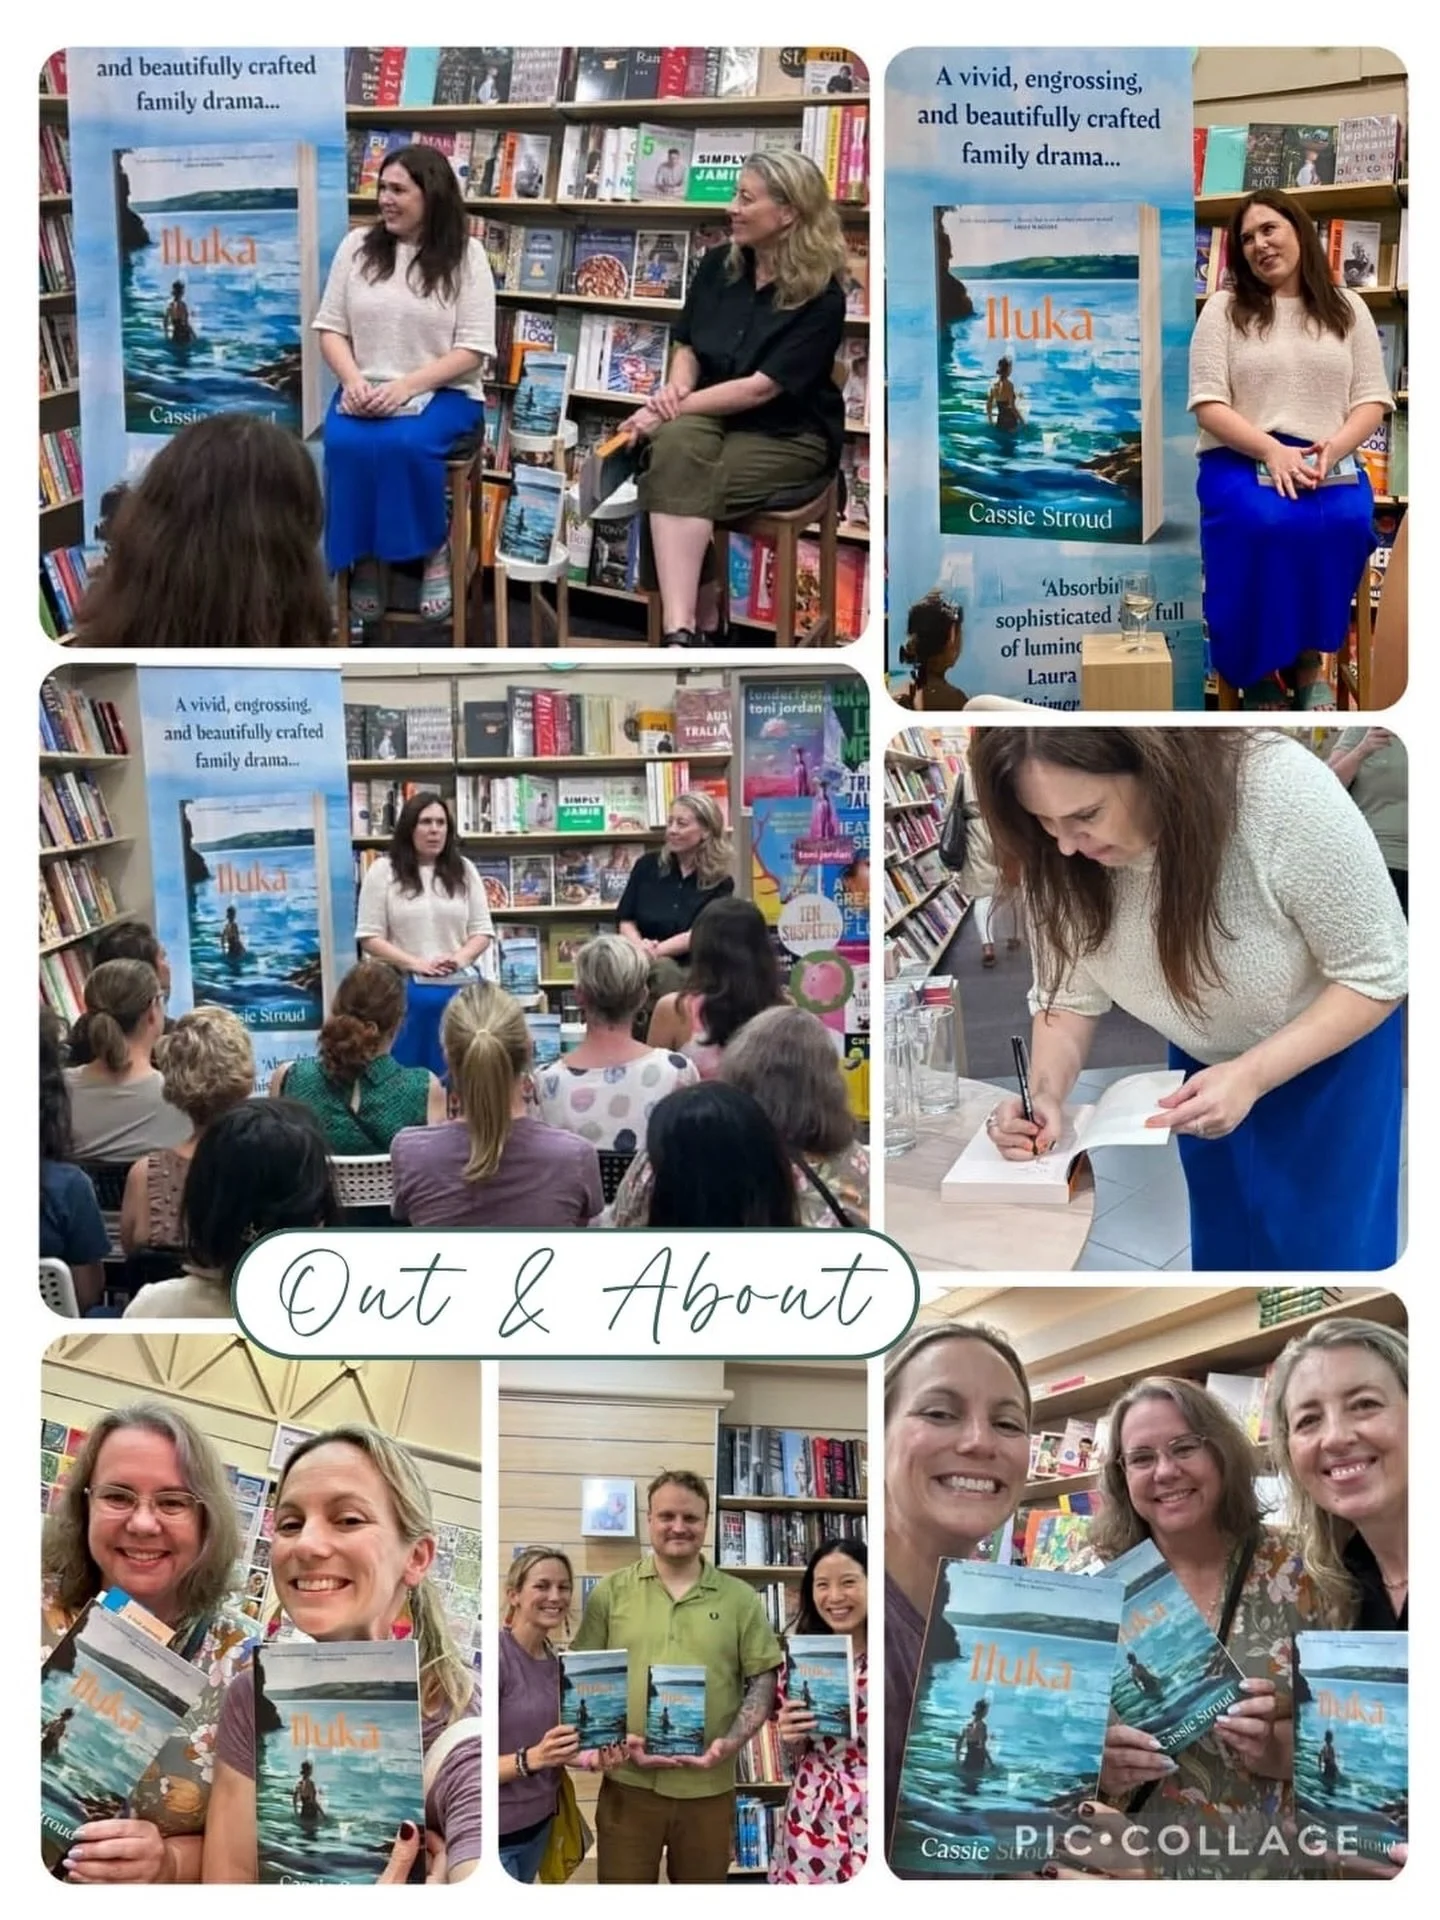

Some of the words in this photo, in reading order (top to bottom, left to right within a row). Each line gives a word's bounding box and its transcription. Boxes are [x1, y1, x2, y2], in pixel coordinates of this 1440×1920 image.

[97, 57, 133, 77] and
[139, 56, 243, 79] beautifully
[249, 54, 317, 75] crafted
[936, 66, 952, 86] A
[960, 65, 1018, 91] vivid,
[1025, 70, 1143, 95] engrossing,
[137, 91, 198, 115] family
[203, 90, 280, 111] drama...
[918, 103, 958, 125] and
[966, 103, 1080, 132] beautifully
[1087, 108, 1161, 130] crafted
[962, 142, 1029, 169] family
[1036, 144, 1121, 167] drama...
[160, 226, 257, 266] Iluka
[986, 294, 1093, 340] Iluka
[969, 502, 1036, 526] Cassie
[1042, 506, 1113, 530] Stroud
[995, 605, 1111, 630] sophisticated
[1155, 602, 1184, 622] full
[1001, 636, 1020, 657] of
[1027, 668, 1077, 686] Laura
[175, 696, 187, 713] A
[191, 696, 230, 715] vivid,
[235, 698, 312, 716] engrossing,
[778, 700, 823, 716] jordan
[164, 725, 192, 741] and
[197, 724, 271, 743] beautifully
[277, 724, 324, 740] crafted
[195, 752, 240, 771] family
[244, 752, 300, 768] drama...
[216, 860, 287, 895] Iluka
[259, 1007, 306, 1023] Stroud
[968, 1643, 1074, 1691] Iluka
[67, 1668, 144, 1736] Iluka
[1196, 1690, 1237, 1726] Stroud
[1316, 1690, 1385, 1725] Iluka
[290, 1712, 381, 1751] Iluka
[921, 1837, 990, 1861] Cassie
